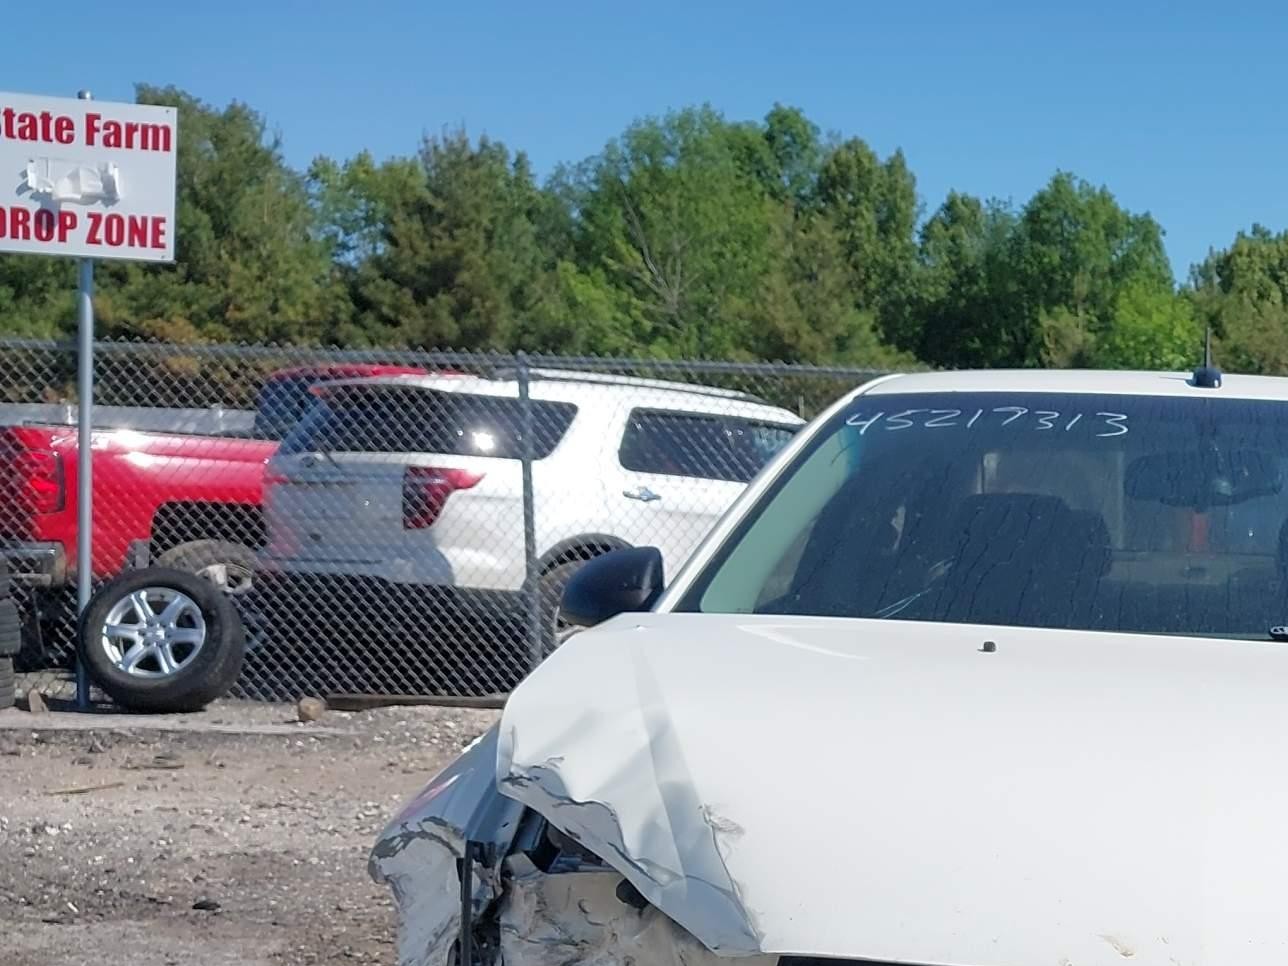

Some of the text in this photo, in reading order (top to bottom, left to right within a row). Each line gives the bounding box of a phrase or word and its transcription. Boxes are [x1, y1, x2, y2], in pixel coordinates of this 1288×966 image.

[0, 107, 172, 152] tate Farm
[86, 212, 166, 249] ZONE
